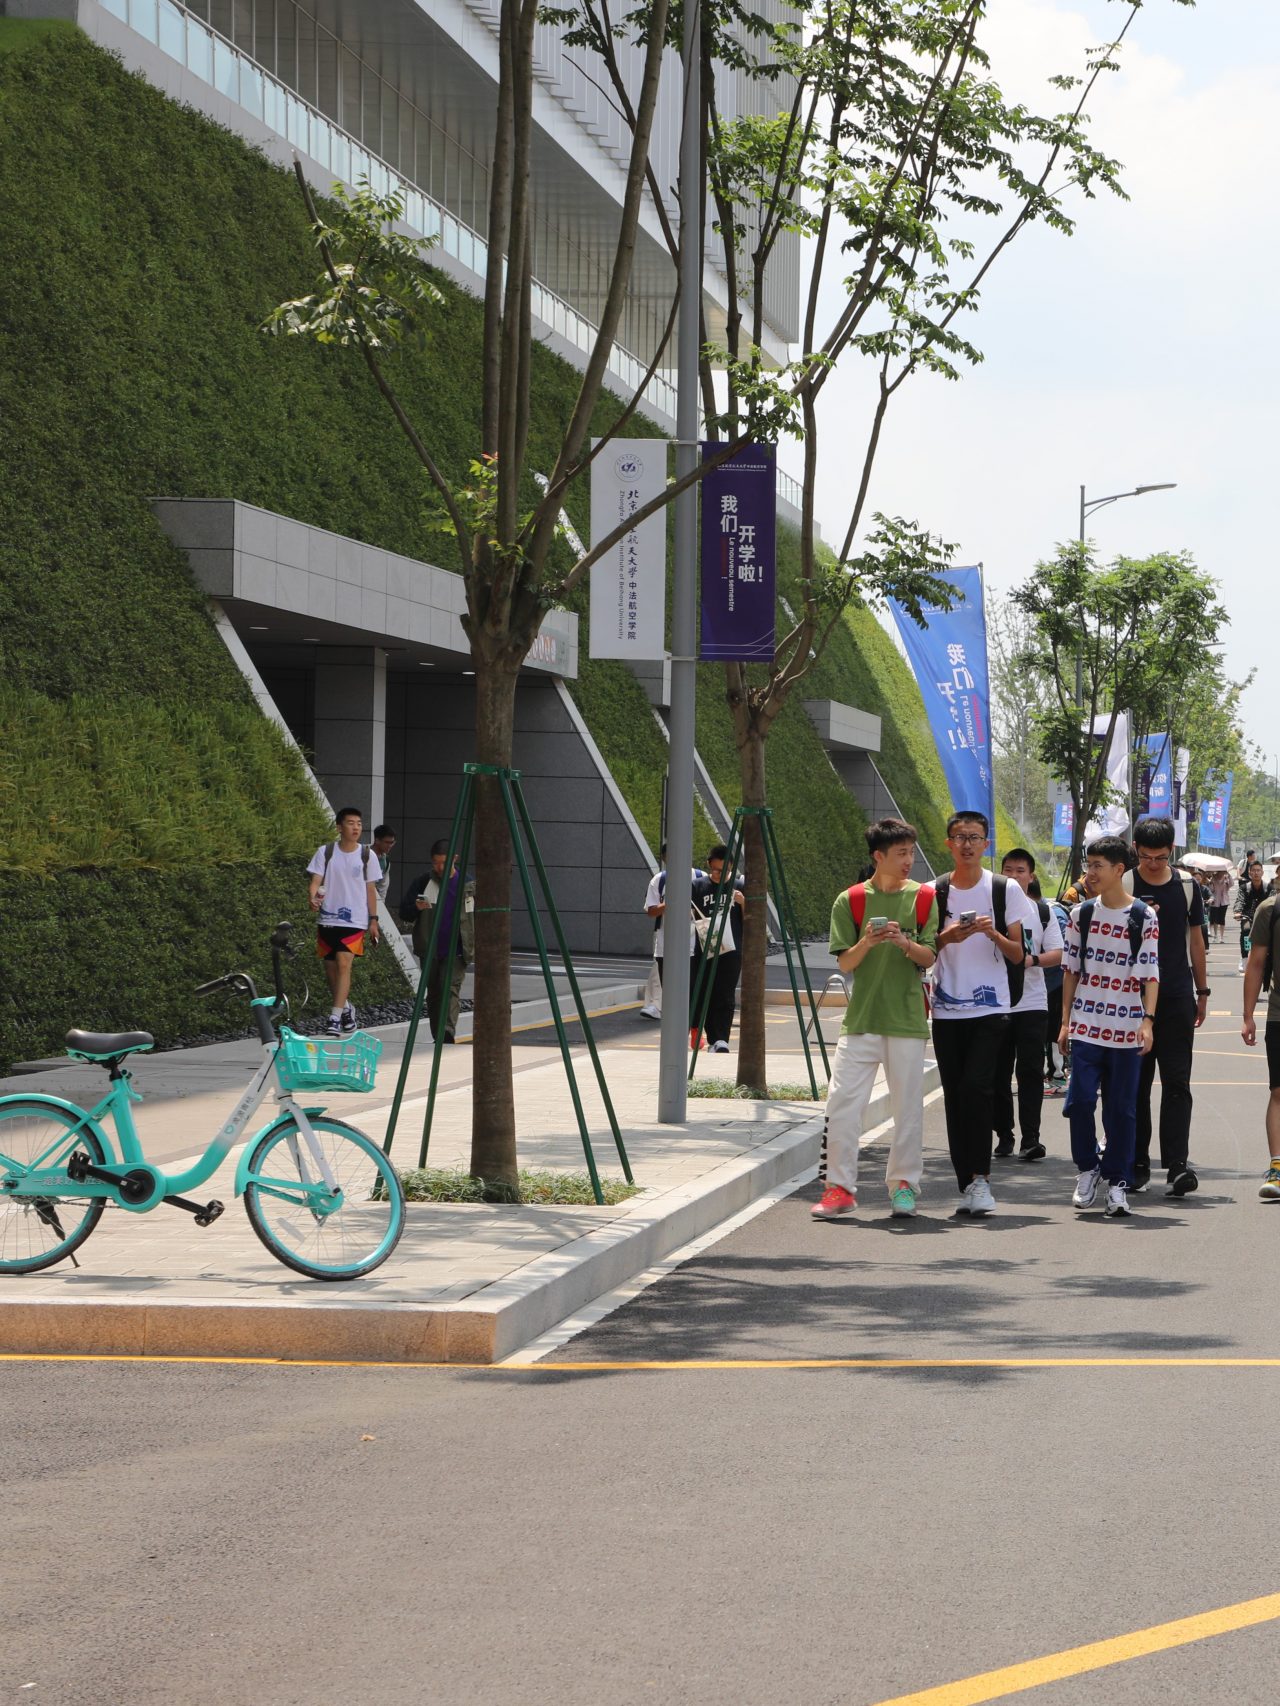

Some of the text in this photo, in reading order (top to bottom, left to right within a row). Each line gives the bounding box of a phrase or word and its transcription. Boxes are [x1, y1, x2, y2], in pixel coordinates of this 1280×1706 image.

[720, 495, 738, 533] 我们
[618, 545, 626, 572] Institute
[728, 547, 736, 578] nouveau
[728, 579, 736, 612] semestre
[616, 608, 625, 640] University
